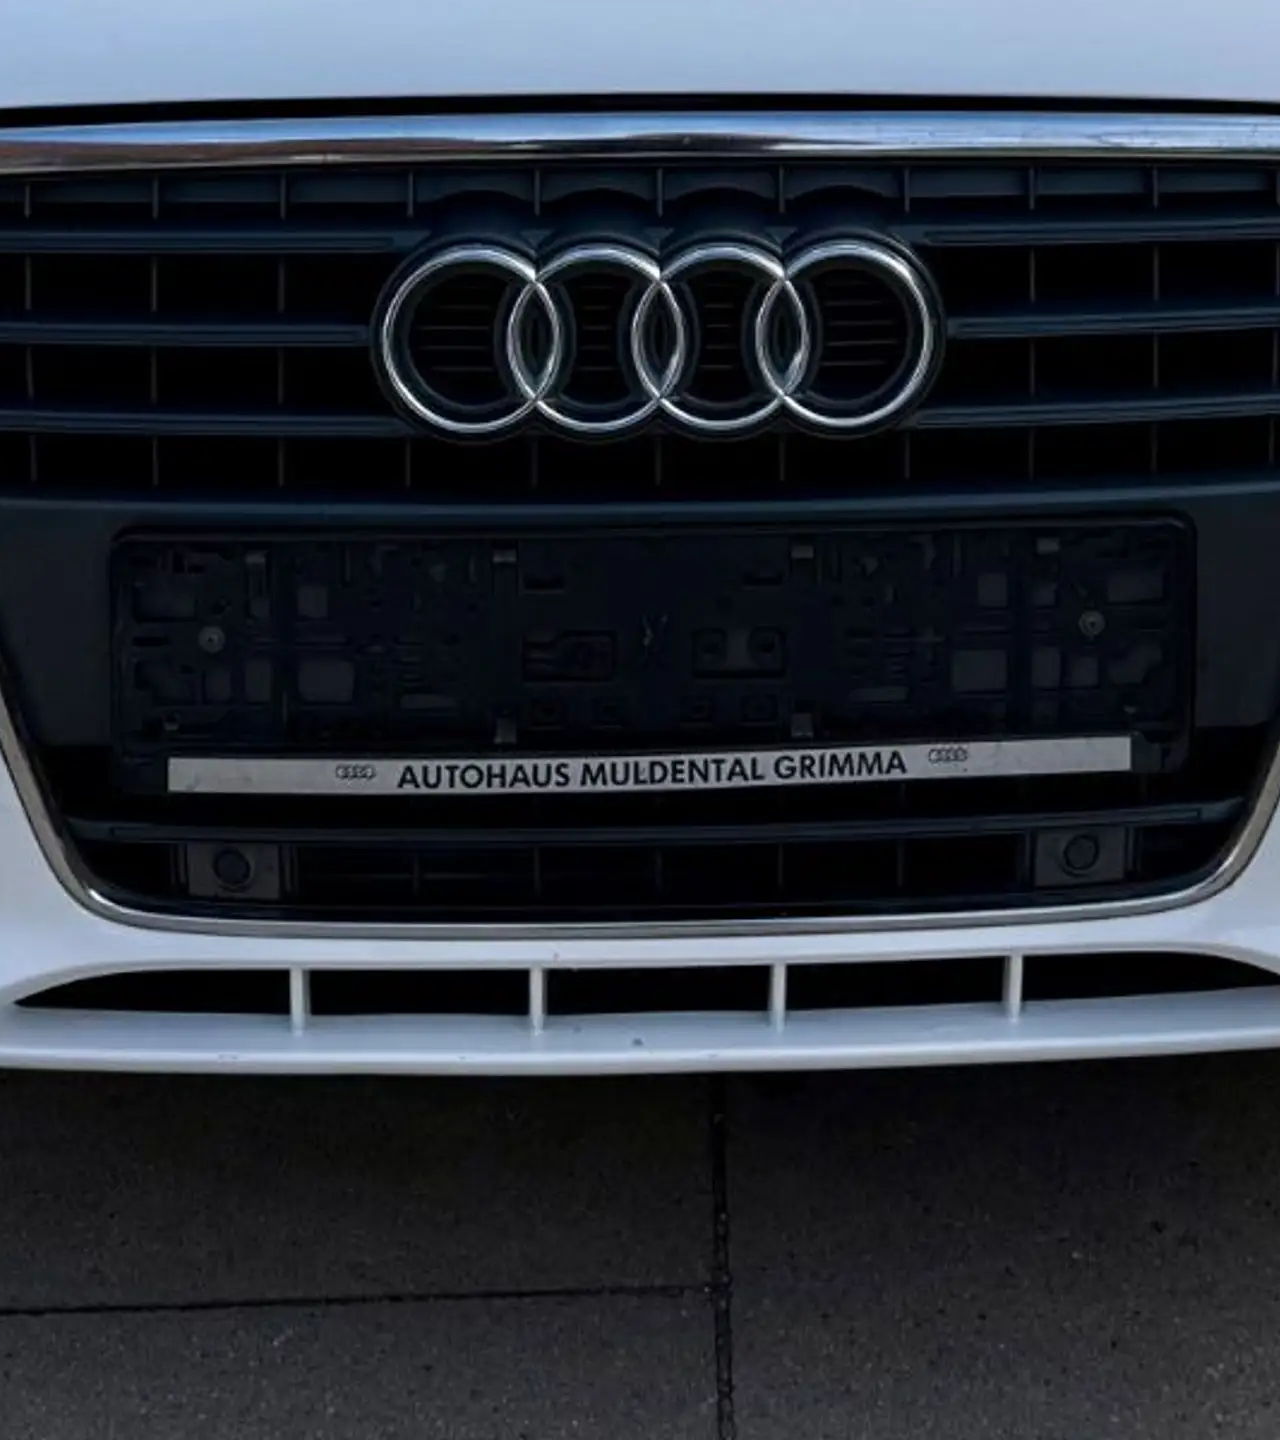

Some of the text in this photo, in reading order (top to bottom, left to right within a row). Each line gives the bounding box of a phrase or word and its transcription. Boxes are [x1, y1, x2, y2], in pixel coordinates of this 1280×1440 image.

[397, 750, 908, 790] AUTOHAUS MULDENTAL GRIMMA
